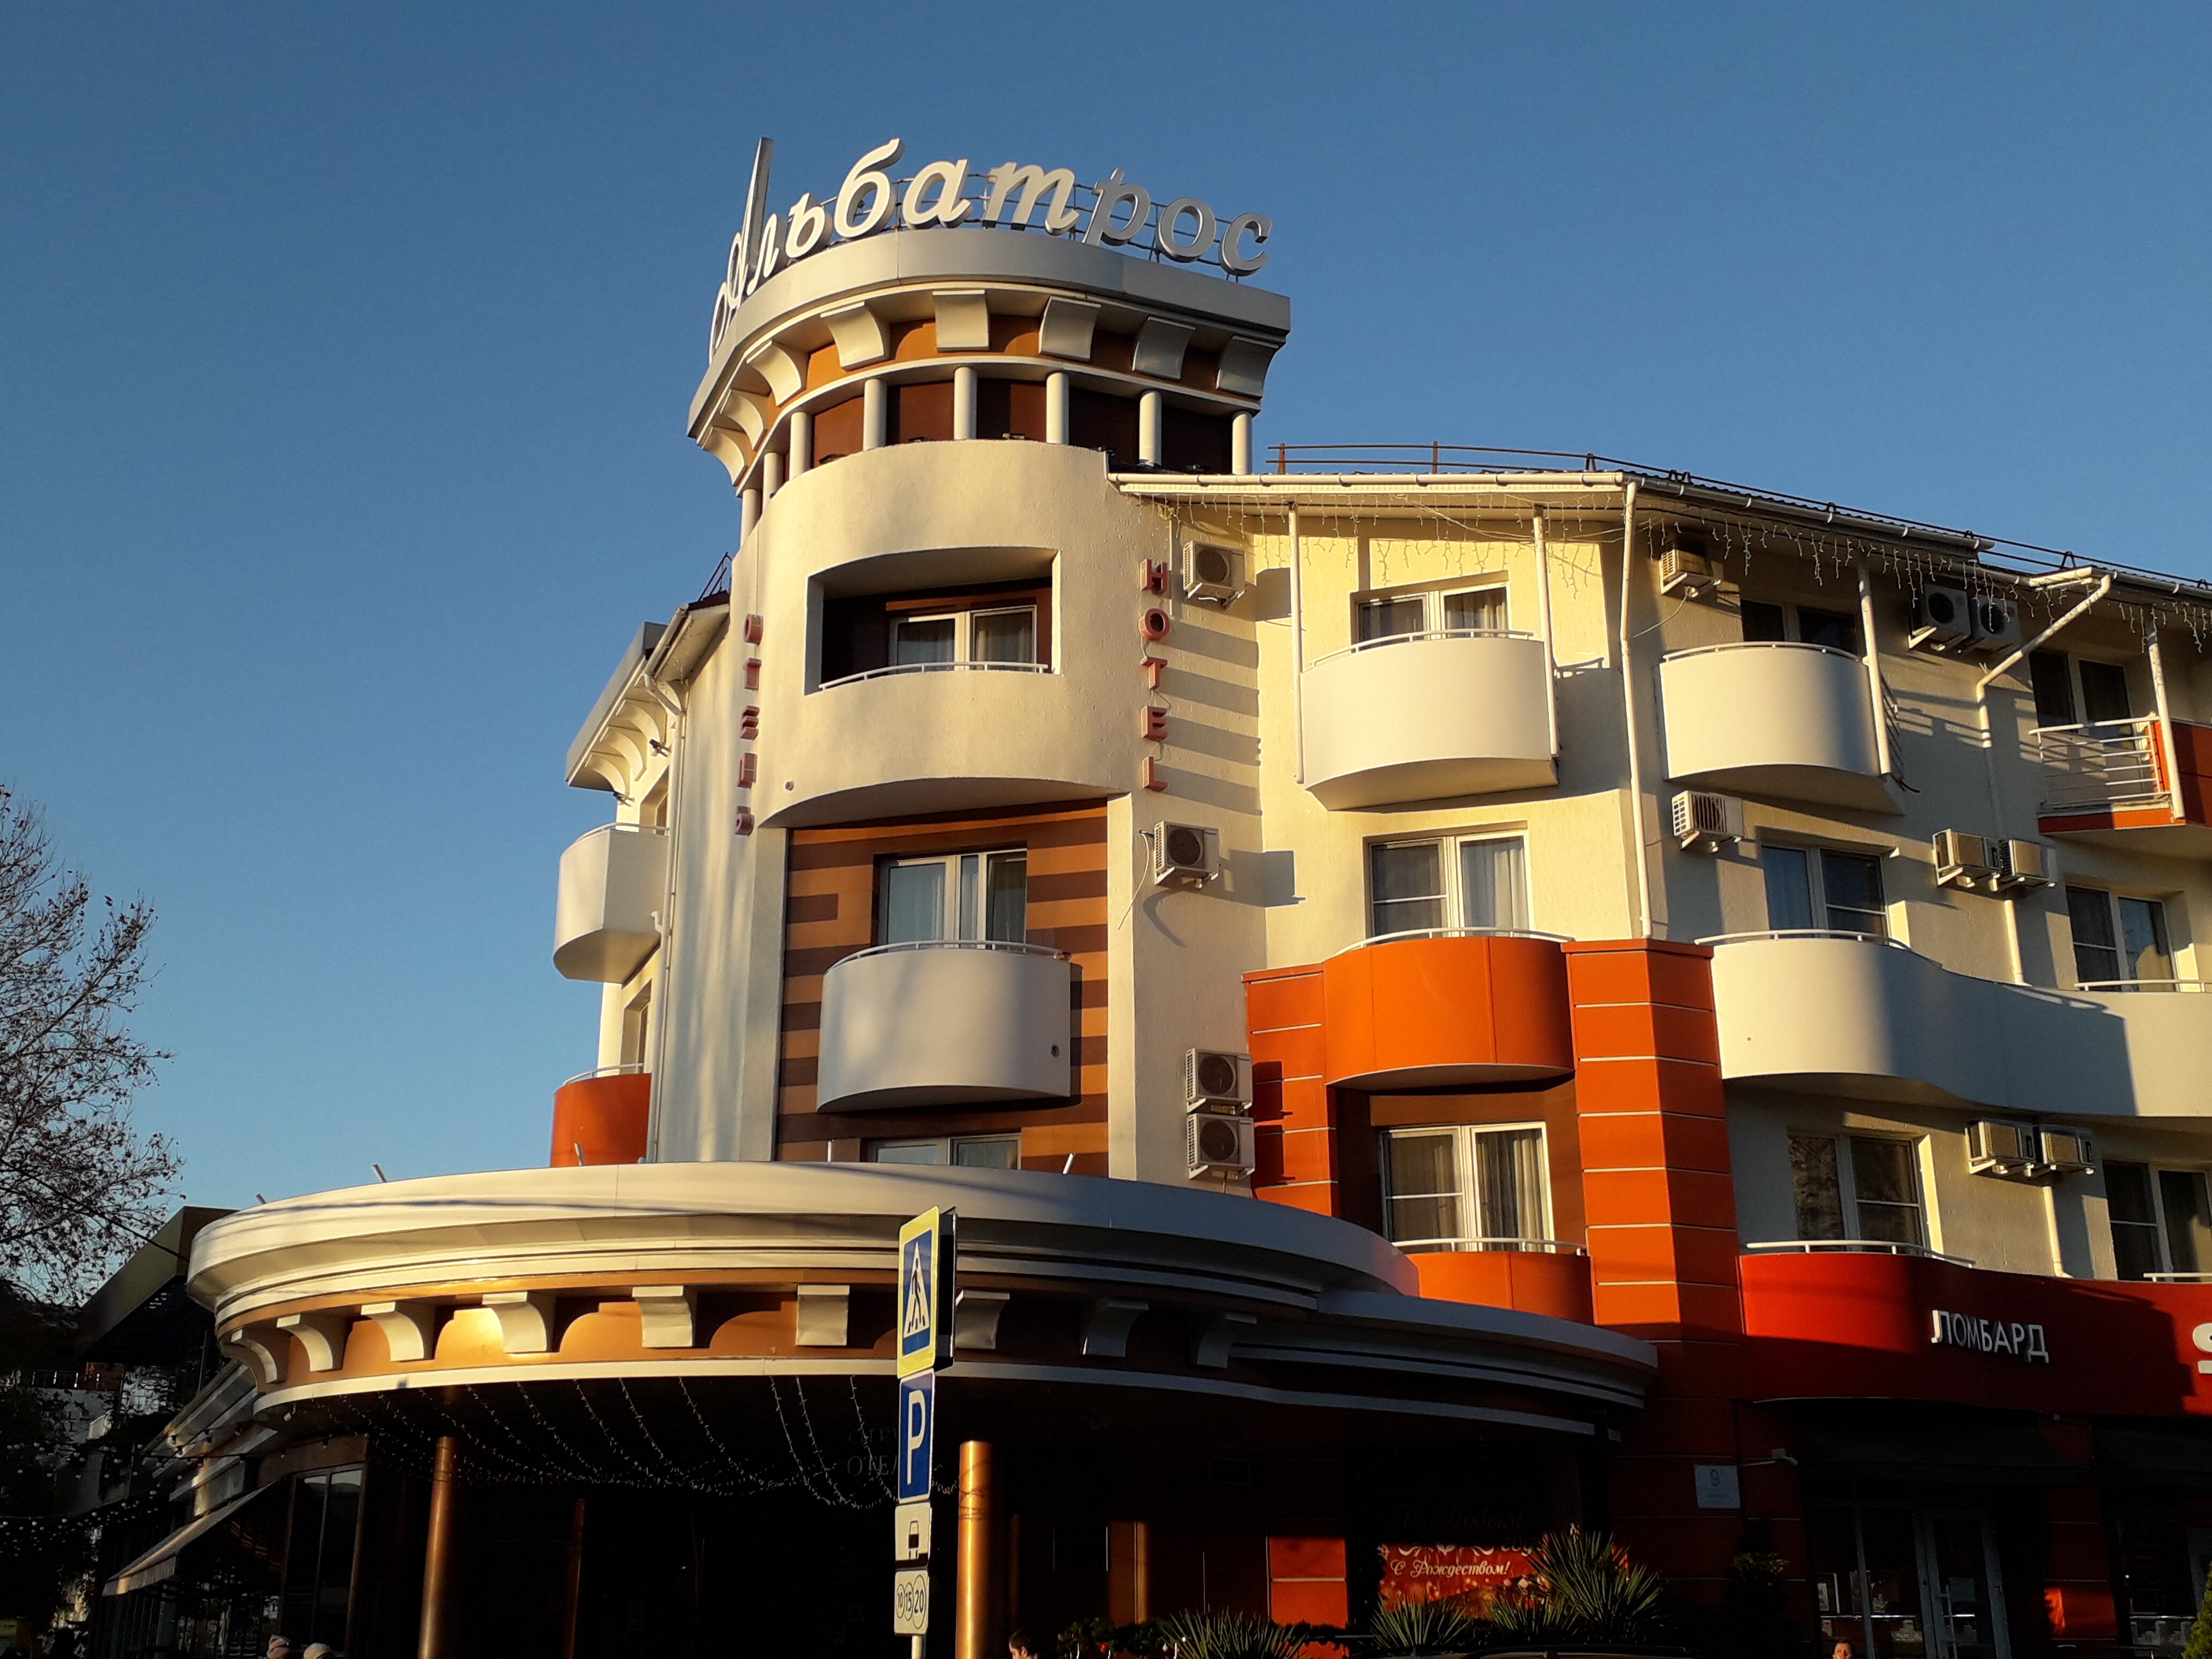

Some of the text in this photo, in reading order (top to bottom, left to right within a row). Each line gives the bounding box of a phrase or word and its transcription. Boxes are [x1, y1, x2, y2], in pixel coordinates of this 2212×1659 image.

[1138, 557, 1170, 792] HOTEL
[1931, 1310, 2050, 1364] ЛОМБАРД
[1389, 1559, 1511, 1579] С Рождеством!
[905, 1591, 912, 1612] 15
[914, 1589, 924, 1614] 20
